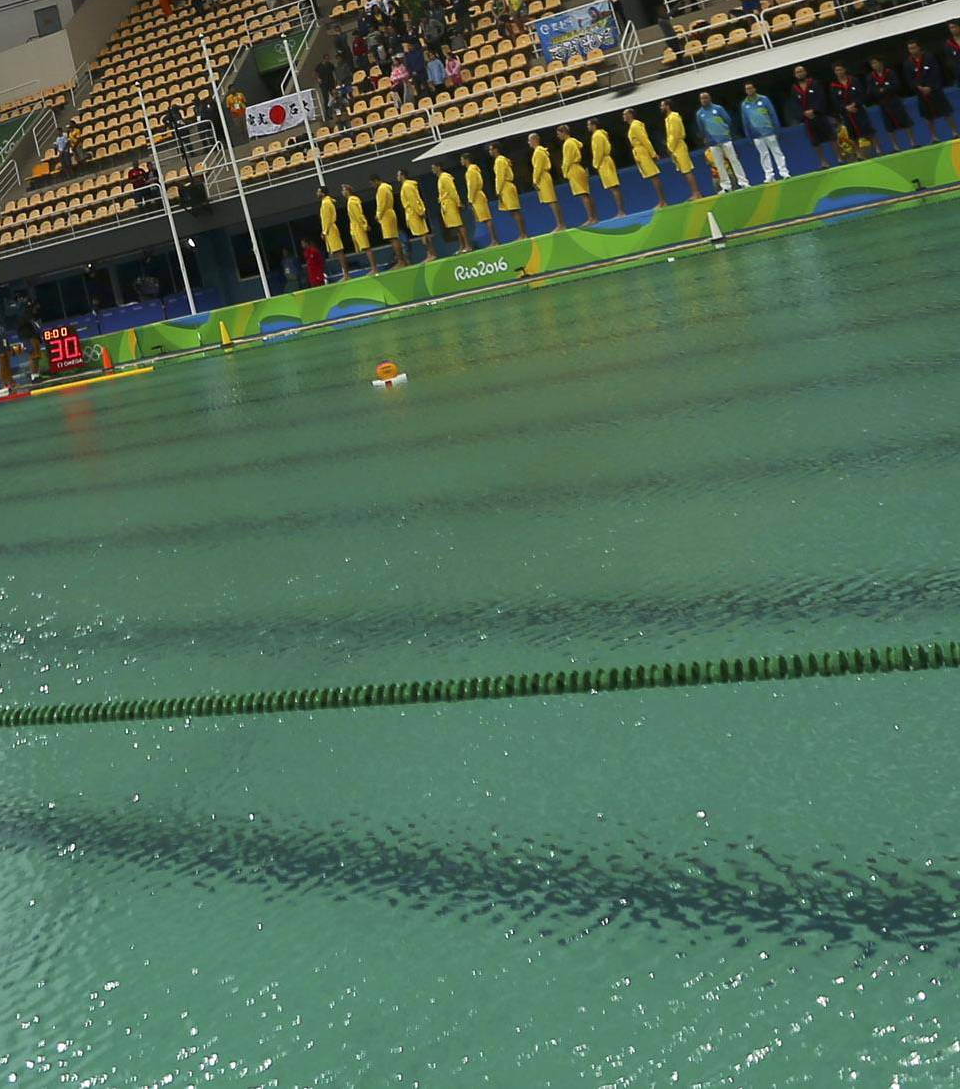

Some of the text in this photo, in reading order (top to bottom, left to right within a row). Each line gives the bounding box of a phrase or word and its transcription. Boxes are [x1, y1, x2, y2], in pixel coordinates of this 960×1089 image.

[454, 256, 508, 281] Rio2016
[44, 327, 68, 340] 8:00
[63, 358, 83, 367] OMEGA
